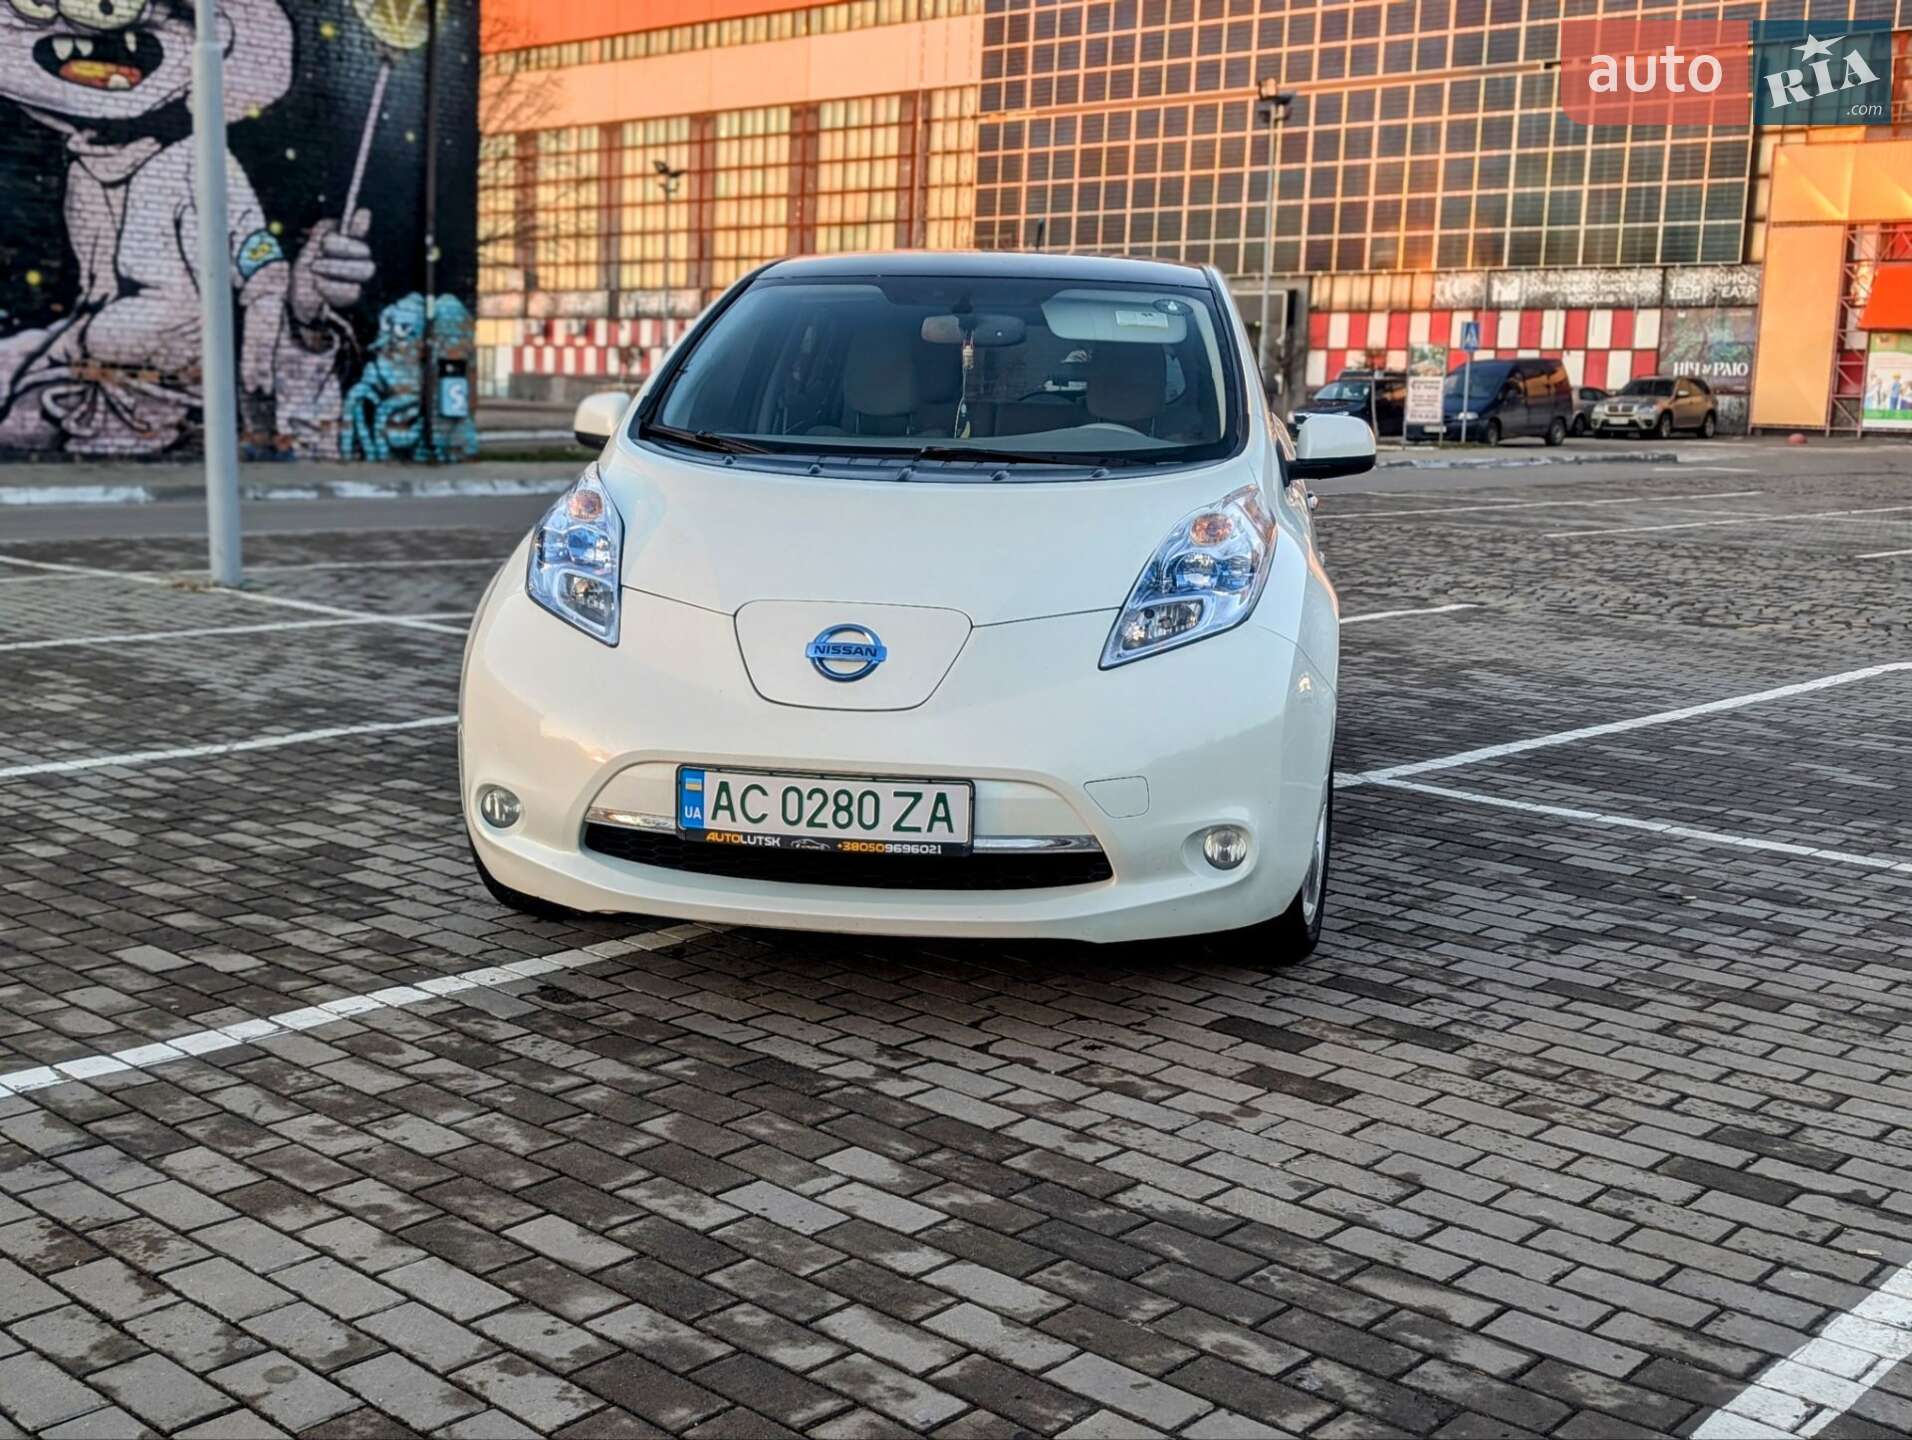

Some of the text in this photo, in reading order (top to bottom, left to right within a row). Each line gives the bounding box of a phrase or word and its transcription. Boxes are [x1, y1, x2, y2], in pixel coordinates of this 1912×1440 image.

[814, 644, 878, 658] NISSAN
[684, 805, 702, 820] UA
[711, 780, 955, 834] AC 0280 ZA
[706, 831, 781, 848] AUTOLUTSK
